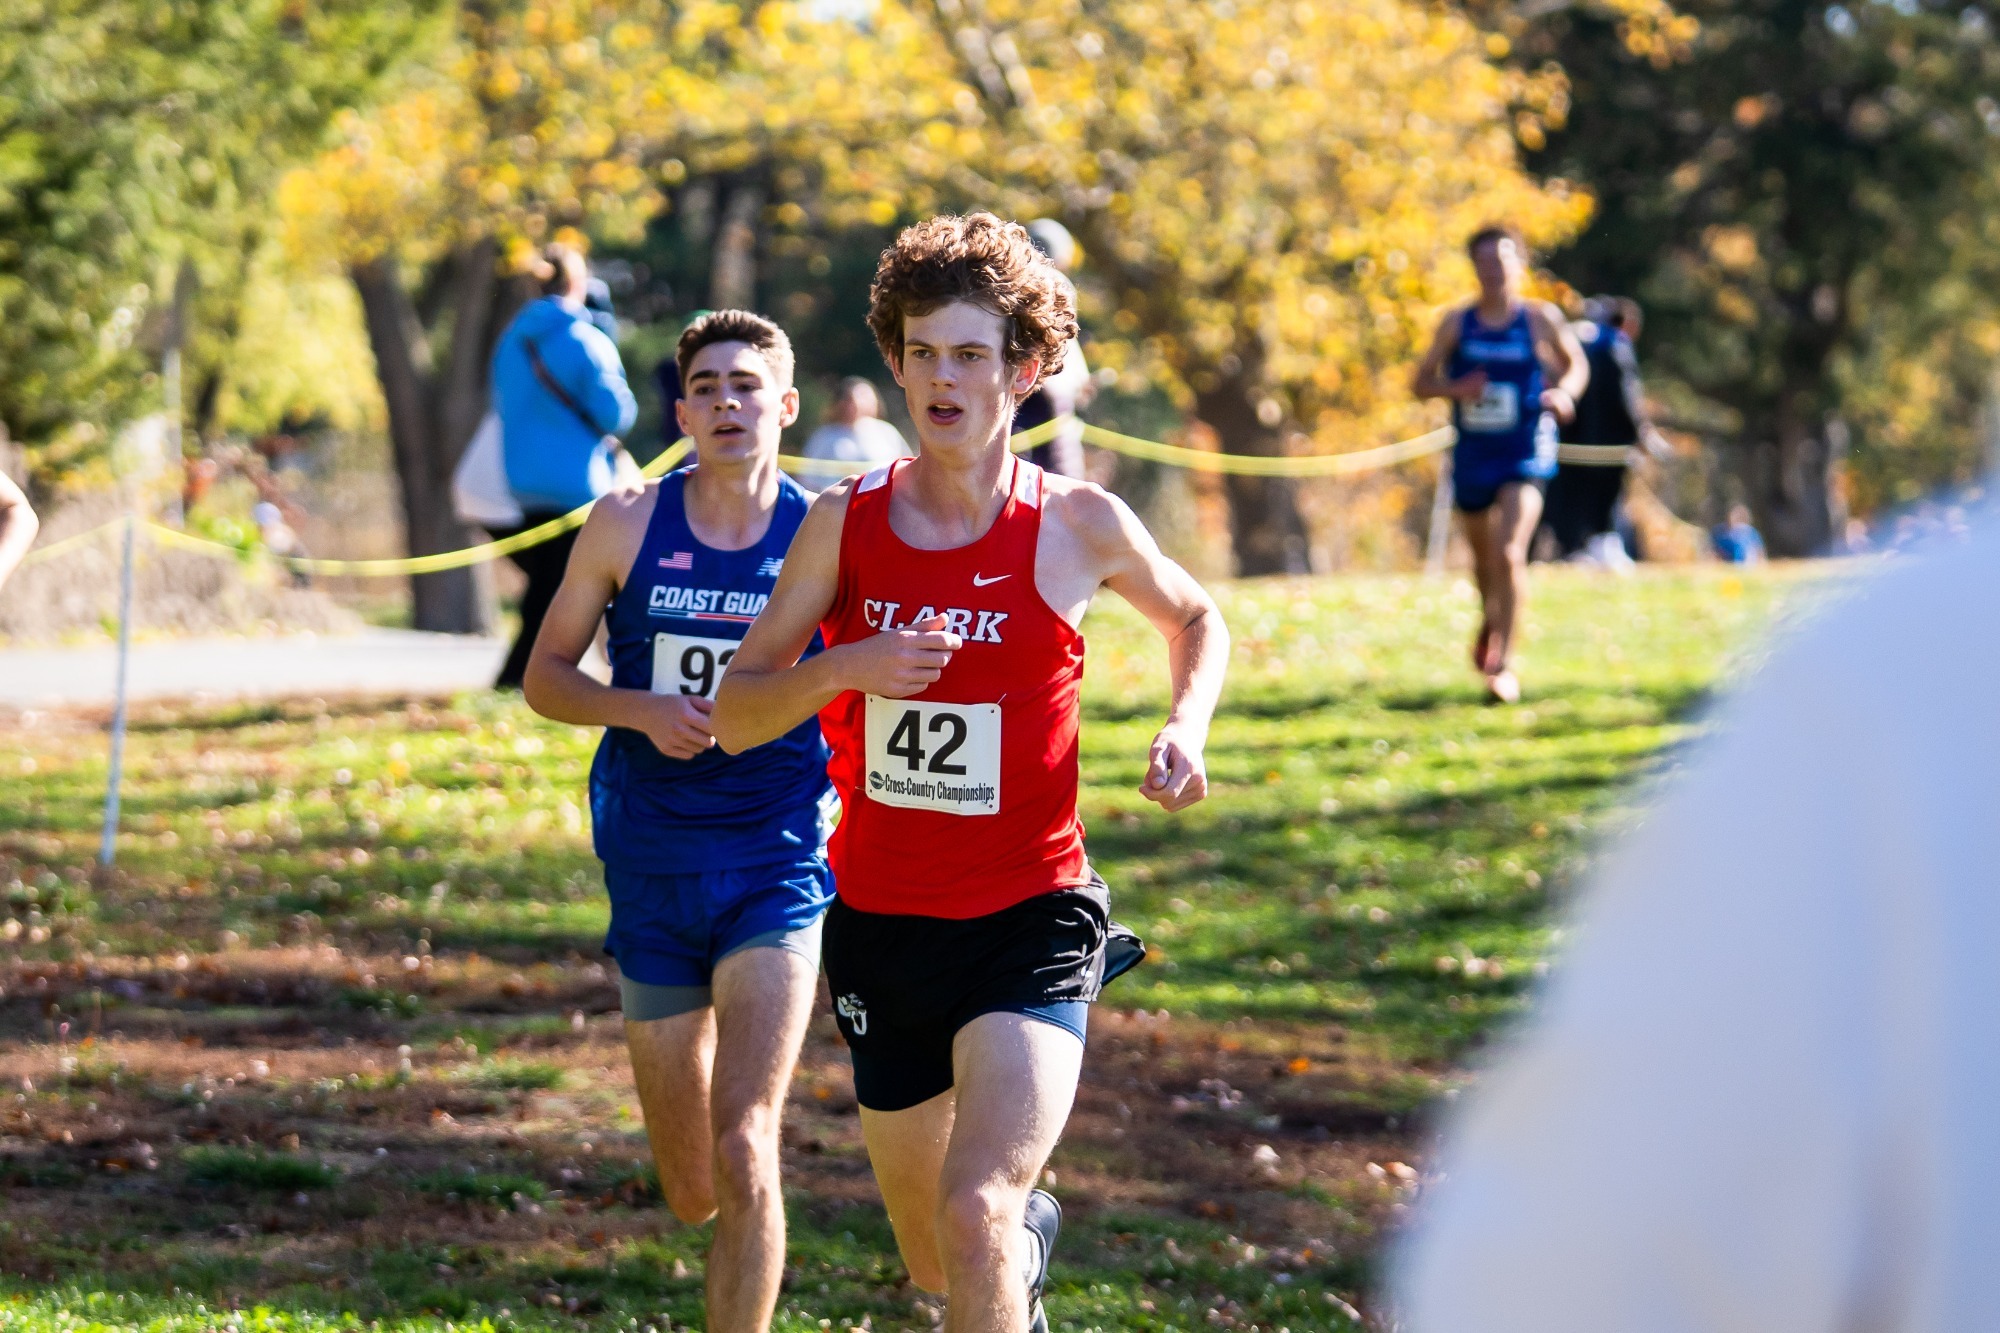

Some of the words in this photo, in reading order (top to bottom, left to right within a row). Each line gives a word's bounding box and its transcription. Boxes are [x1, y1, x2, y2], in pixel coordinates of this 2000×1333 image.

[650, 585, 724, 612] COAST
[723, 591, 769, 615] GUA
[886, 709, 968, 775] 42
[885, 773, 936, 801] Cross-Country
[936, 780, 995, 805] Championships
